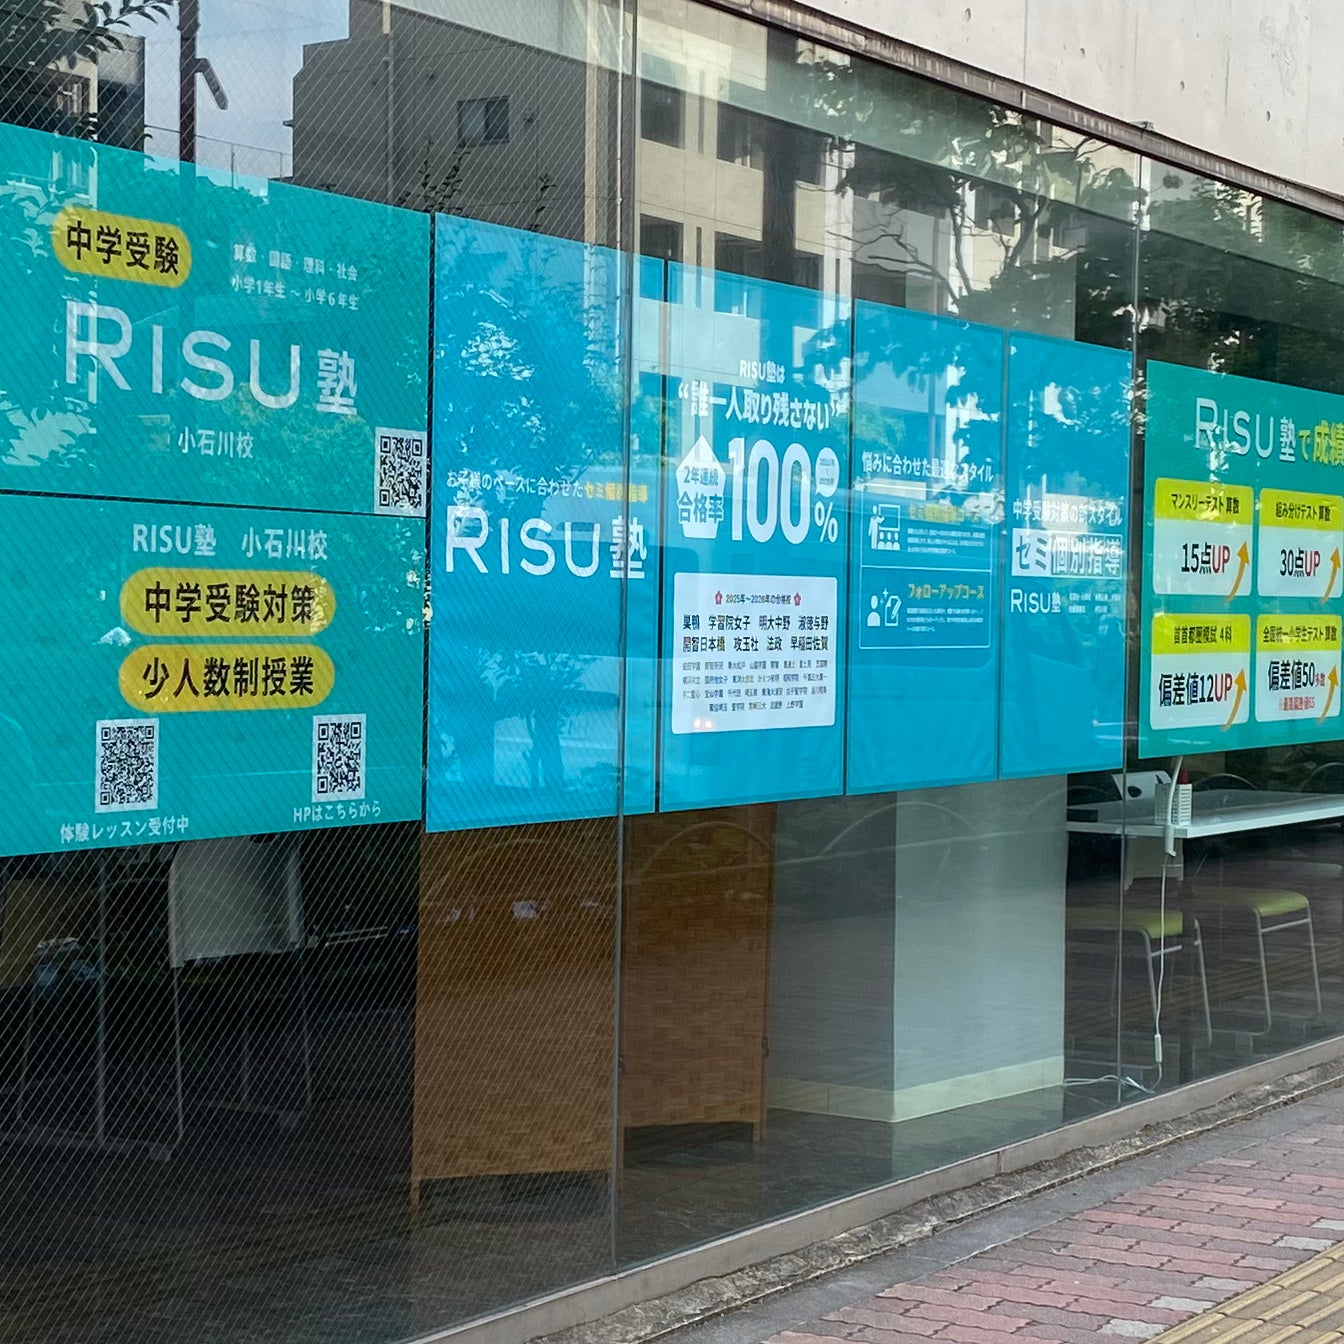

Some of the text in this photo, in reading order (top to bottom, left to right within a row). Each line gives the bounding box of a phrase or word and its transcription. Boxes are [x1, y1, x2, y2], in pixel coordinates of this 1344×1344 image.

[66, 219, 181, 276] 中学受験
[65, 299, 358, 416] RISU塾
[177, 427, 254, 460] 小石川校
[678, 491, 724, 524] 合格率
[133, 523, 328, 561] RISU塾 小石川校
[446, 505, 648, 579] RISU塾
[1181, 542, 1231, 575] 15点UP
[1280, 547, 1321, 578] 30点UP
[145, 581, 316, 625] 中学受験対策
[1011, 589, 1062, 614] RISU塾
[141, 655, 315, 699] 少人数制授業
[1158, 672, 1234, 708] 偏差値12UP
[60, 814, 190, 844] 体験レッスン受付中
[293, 801, 382, 823] HPはこちらから
